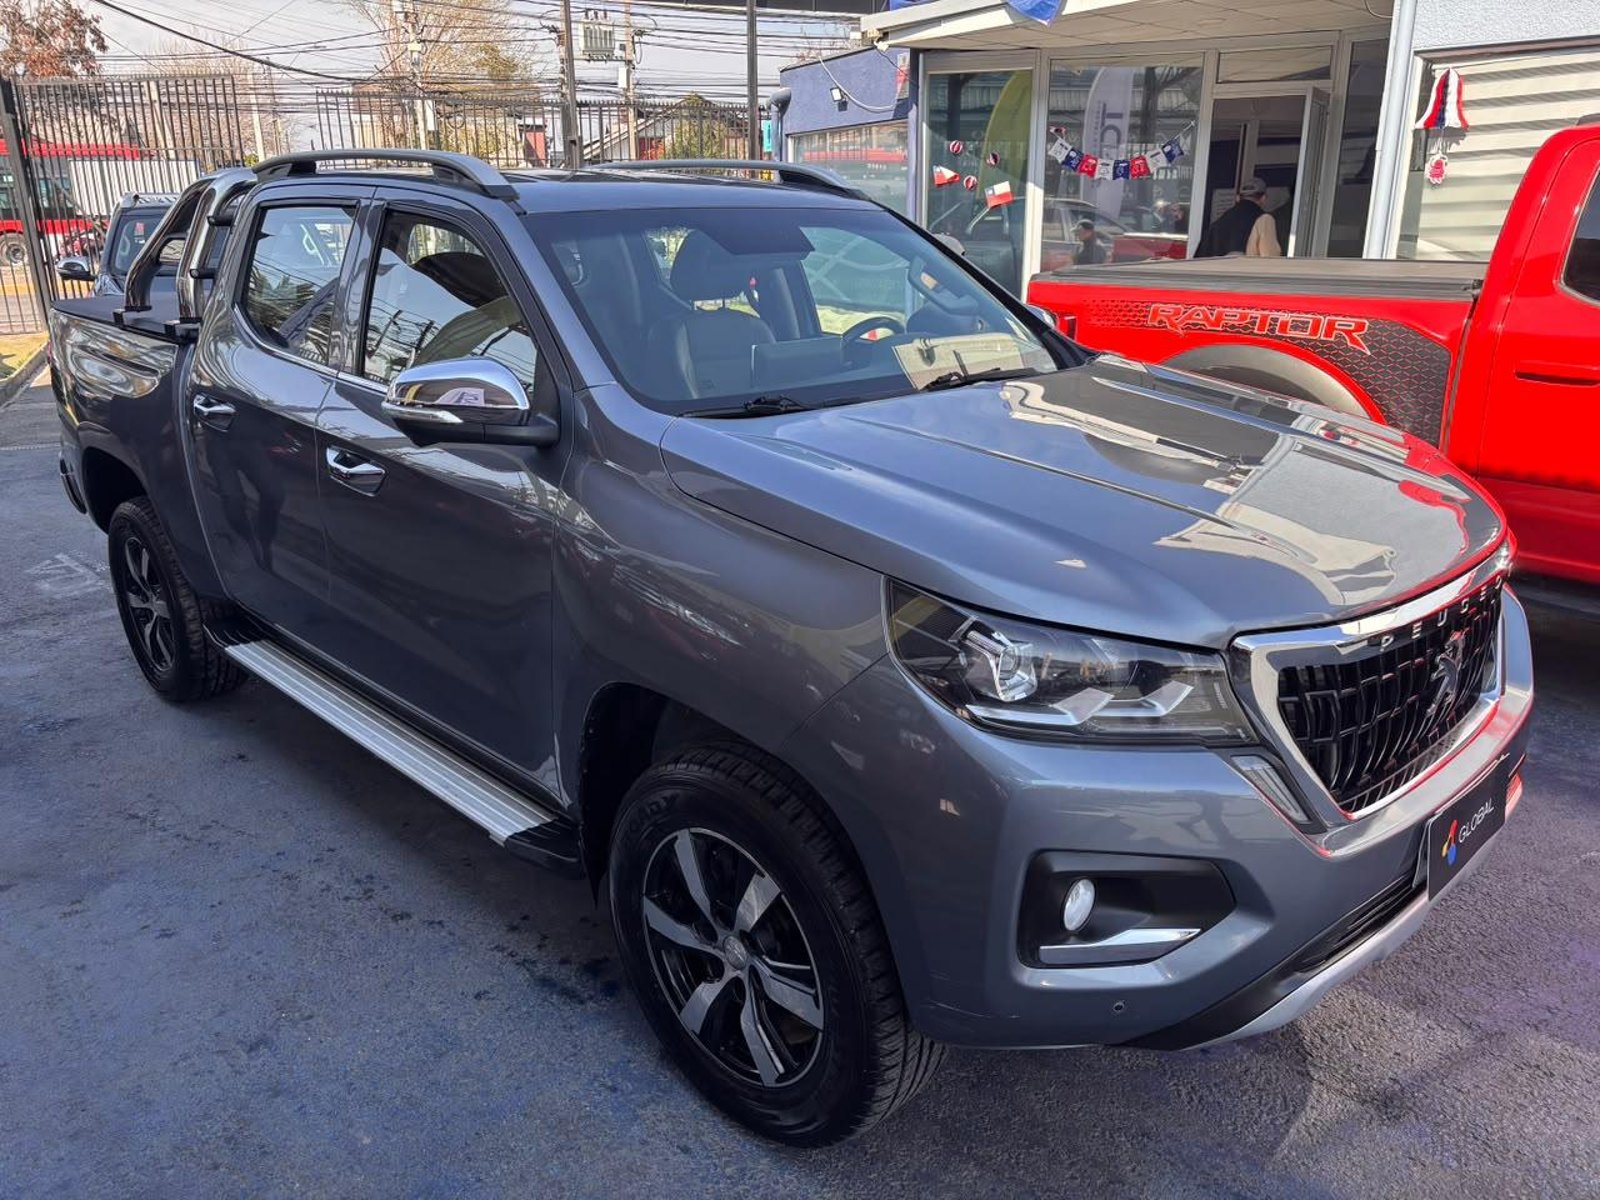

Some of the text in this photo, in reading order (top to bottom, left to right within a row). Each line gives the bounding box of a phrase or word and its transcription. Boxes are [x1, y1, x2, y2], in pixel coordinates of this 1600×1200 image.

[1148, 303, 1372, 356] RAPTOR
[1380, 574, 1503, 653] PEUGEO
[1458, 798, 1495, 843] GLOBAL
